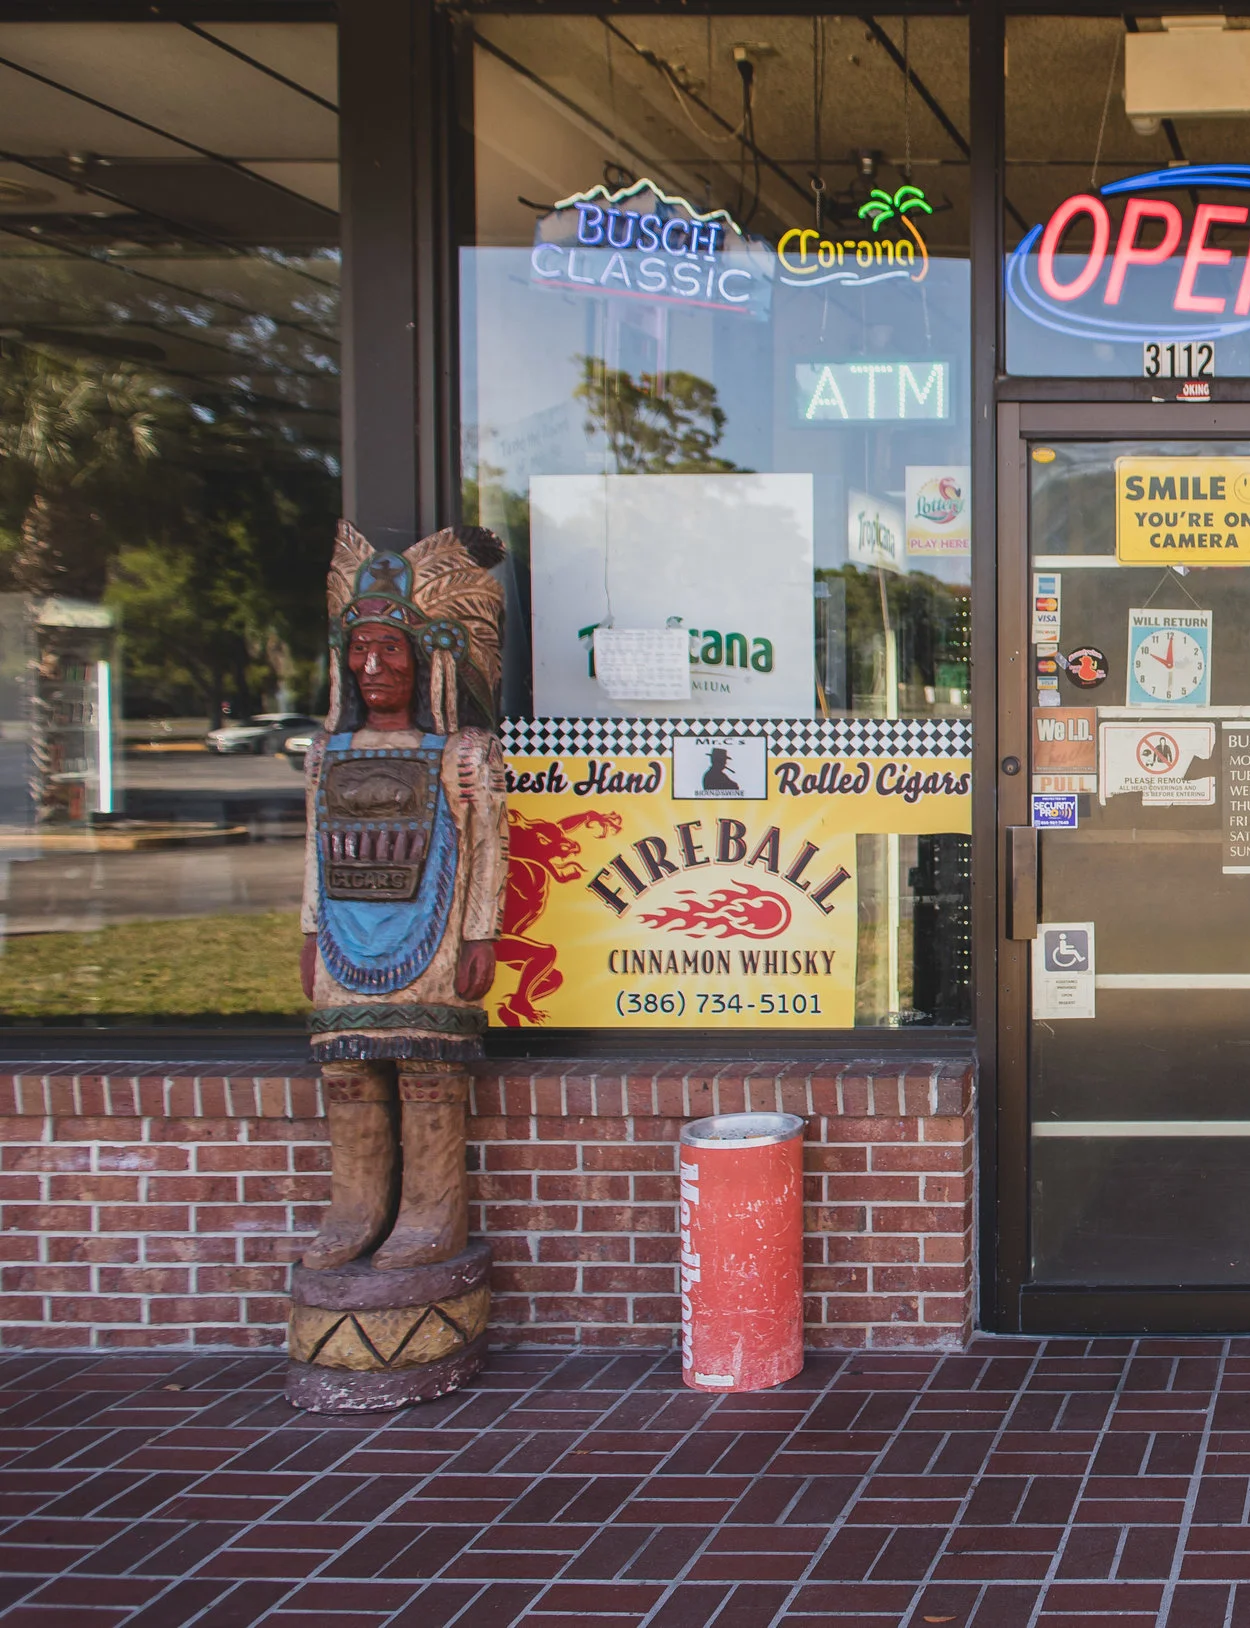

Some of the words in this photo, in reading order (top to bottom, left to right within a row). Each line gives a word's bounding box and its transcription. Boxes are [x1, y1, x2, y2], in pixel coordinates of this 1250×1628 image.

[574, 201, 722, 261] BUSCH
[777, 228, 915, 275] Corona
[530, 242, 752, 303] CLASSIC
[1145, 343, 1214, 377] 3112
[805, 364, 944, 419] ATM
[1125, 475, 1226, 501] SMILE
[1135, 511, 1214, 527] YOU'RE
[910, 539, 937, 548] PLAY
[940, 539, 969, 548] HERE
[1150, 533, 1239, 549] CAMERA
[1133, 616, 1160, 625] WILL
[1163, 617, 1208, 627] RETURN
[1184, 636, 1187, 644] 1
[1141, 646, 1149, 655] 10
[1194, 648, 1198, 656] 2
[1136, 660, 1141, 668] 9
[1140, 675, 1145, 683] 8
[1192, 676, 1197, 684] 4
[1152, 686, 1156, 694] 7
[1167, 691, 1171, 699] 6
[1181, 687, 1186, 695] 5
[1036, 718, 1065, 742] We
[1068, 718, 1094, 742] I.D.
[503, 761, 569, 793] resh
[573, 759, 664, 796] Hand
[774, 761, 873, 797] Rolled
[875, 763, 973, 803] Cigars
[1040, 776, 1092, 792] PULL
[1034, 801, 1075, 810] SECURITY
[1040, 809, 1059, 817] PRO
[1230, 816, 1247, 826] FRI
[1229, 831, 1250, 842] SAT
[585, 816, 852, 918] FIREBALL
[607, 948, 732, 977] CINNAMON
[737, 949, 836, 977] WHISKY
[615, 989, 687, 1017] (386)
[696, 992, 823, 1015] 734-5101
